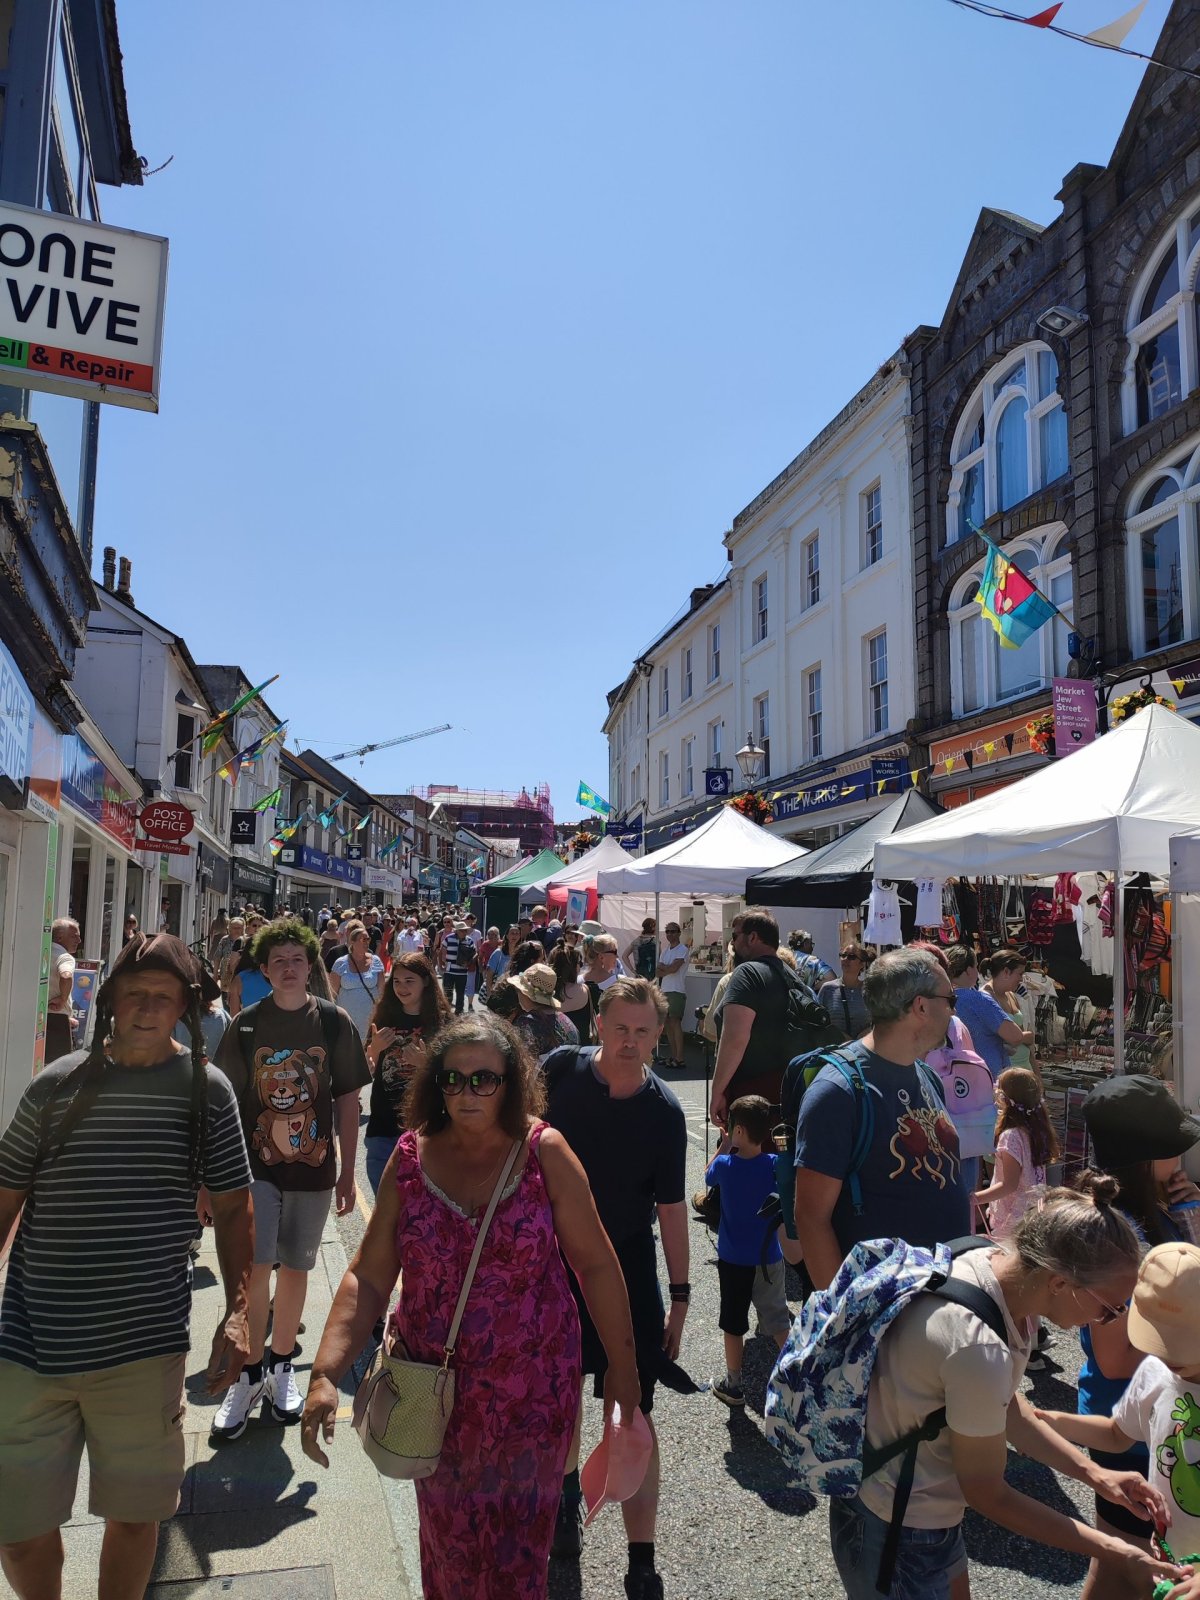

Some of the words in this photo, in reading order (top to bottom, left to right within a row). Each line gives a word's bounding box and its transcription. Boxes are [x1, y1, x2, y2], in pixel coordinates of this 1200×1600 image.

[6, 278, 140, 346] VIVE
[31, 346, 50, 366] &
[59, 351, 135, 382] Repair
[1055, 686, 1086, 696] Market
[1055, 695, 1073, 704] Jew
[1056, 703, 1082, 713] Street
[781, 795, 801, 814] THE
[153, 808, 185, 821] POST
[144, 818, 187, 832] OFFICE
[144, 841, 162, 850] Travel
[161, 843, 182, 853] Money
